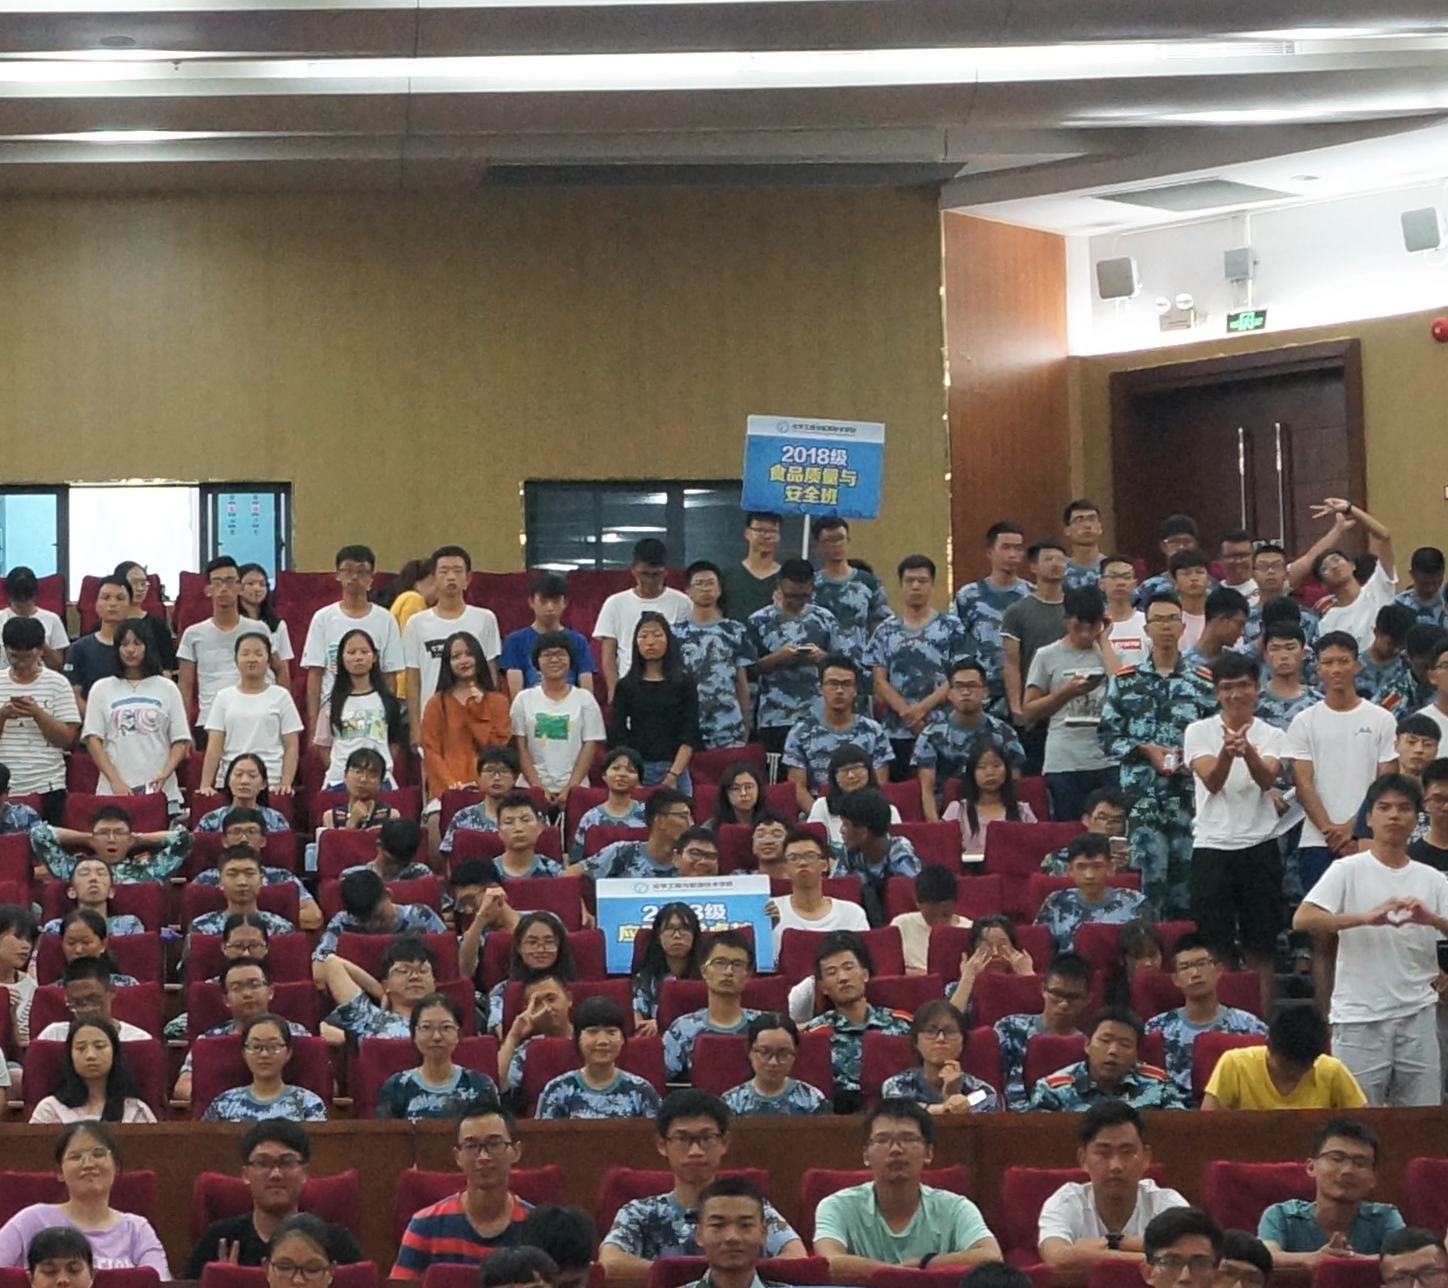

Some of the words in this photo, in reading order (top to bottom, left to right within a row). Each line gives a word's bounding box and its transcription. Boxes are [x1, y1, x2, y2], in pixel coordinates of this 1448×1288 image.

[781, 445, 848, 466] 2018级
[785, 486, 837, 505] 安全班
